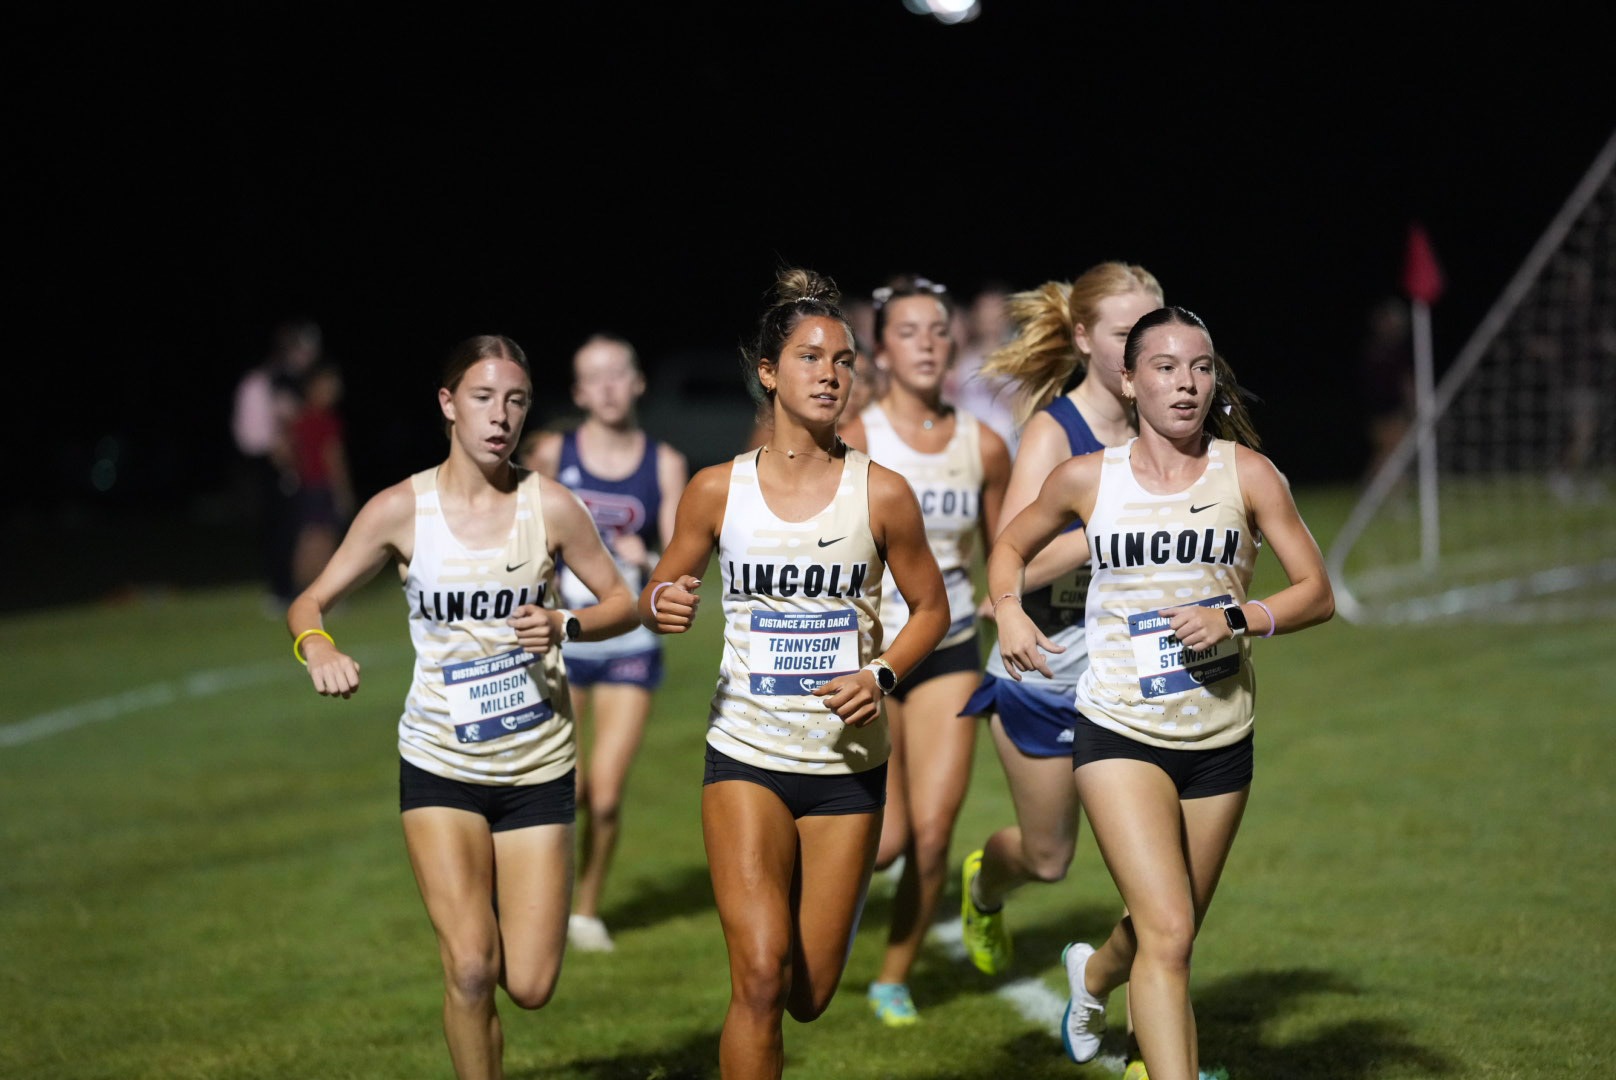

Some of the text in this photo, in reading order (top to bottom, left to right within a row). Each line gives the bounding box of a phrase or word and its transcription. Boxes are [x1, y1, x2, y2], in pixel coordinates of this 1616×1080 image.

[1095, 529, 1239, 569] LINCOLN
[729, 561, 867, 598] LINCOLN
[759, 616, 850, 629] DISTANCE AFTER DARK
[1138, 616, 1170, 630] DISTAN
[769, 637, 841, 653] TENNYSON
[452, 664, 490, 680] DISTANCE
[490, 656, 519, 672] AFTER
[773, 655, 836, 670] HOUSLEY
[469, 672, 529, 700] MADISON
[480, 691, 525, 715] MILLER
